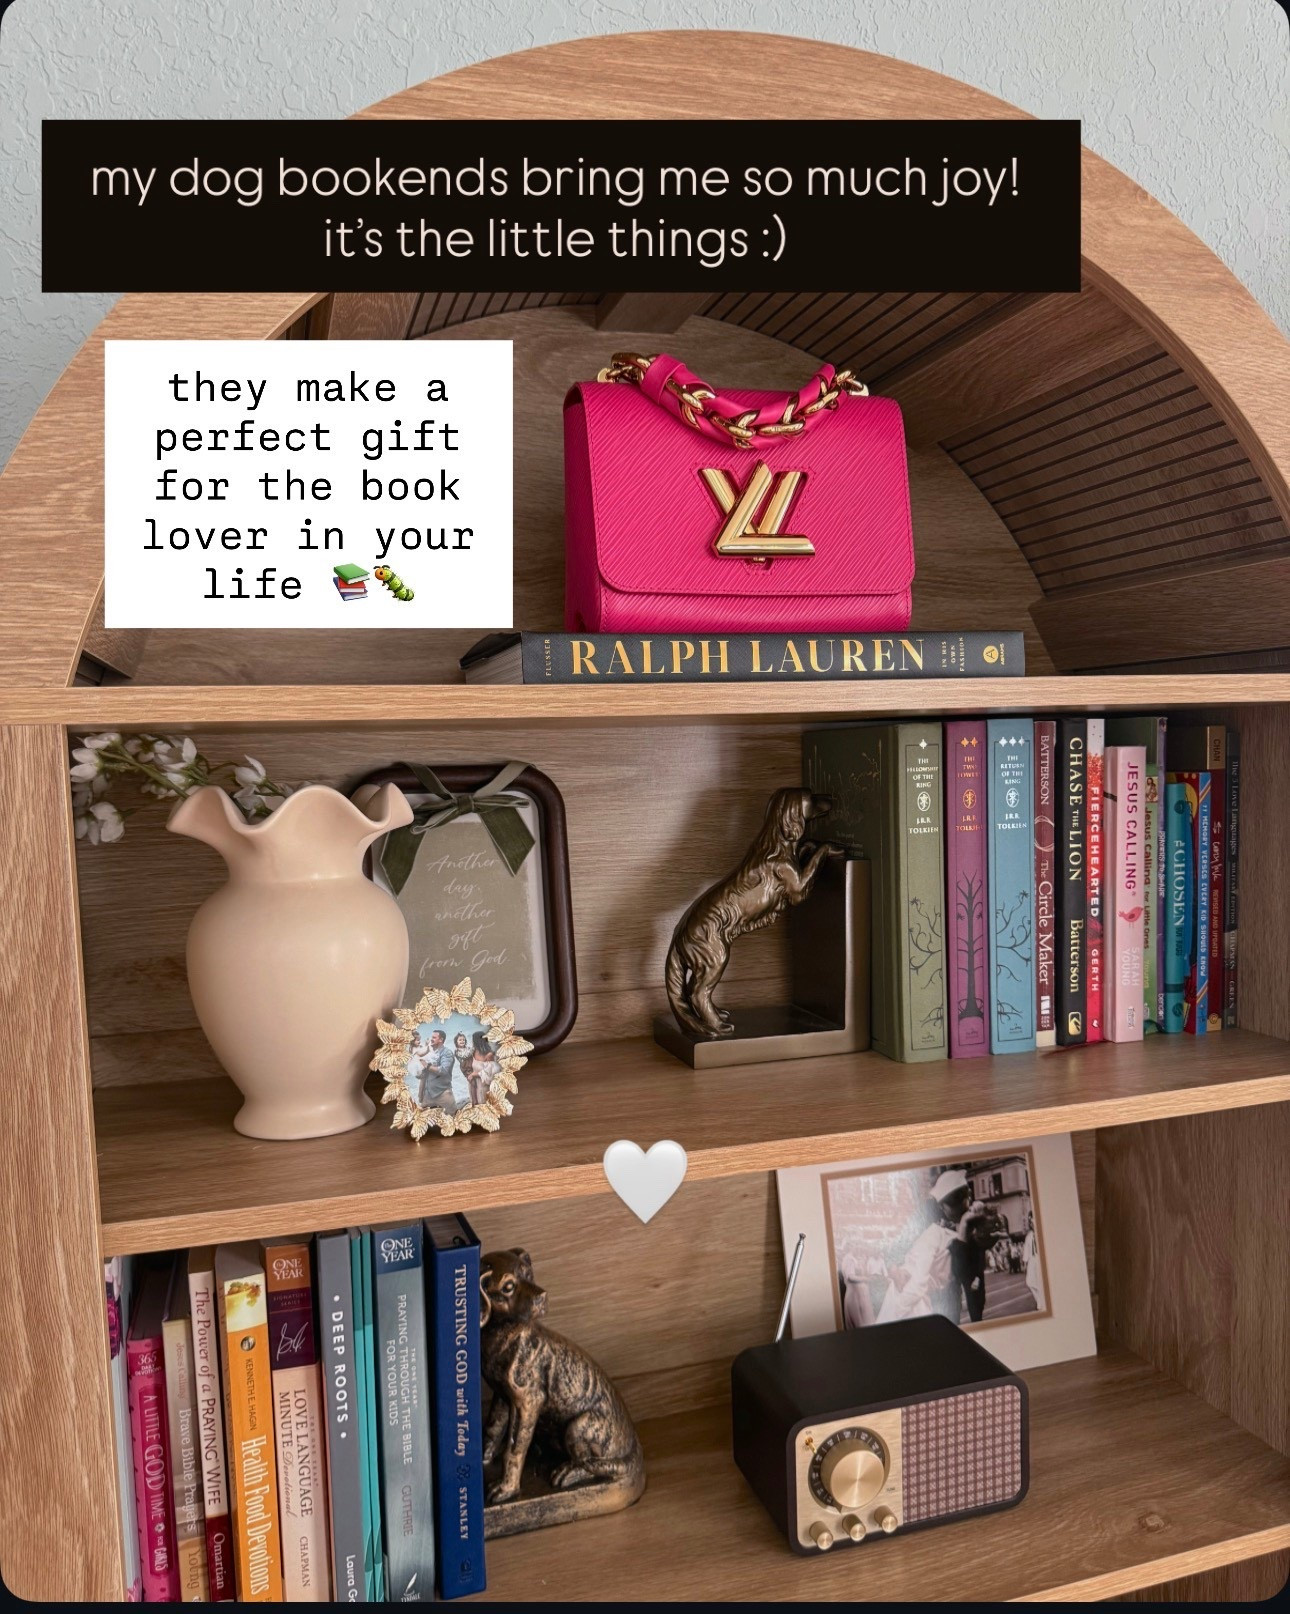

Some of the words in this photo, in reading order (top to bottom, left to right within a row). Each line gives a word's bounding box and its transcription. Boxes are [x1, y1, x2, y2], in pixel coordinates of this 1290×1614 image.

[544, 639, 552, 676] FLUSSER
[570, 640, 730, 675] RALPH
[750, 638, 924, 674] LAUREN
[942, 659, 947, 668] IN
[1213, 738, 1221, 762] CHAN
[1041, 735, 1049, 805] BATTERSON
[1069, 737, 1083, 806] CHASE
[1126, 762, 1139, 814] JESUS
[1144, 807, 1152, 840] Jesus
[1230, 808, 1238, 855] Languages
[426, 851, 502, 873] Another
[1069, 830, 1082, 881] LION
[1091, 787, 1100, 917] FIERCEHEARTED
[1126, 820, 1138, 890] CALLING
[1144, 844, 1152, 885] Calling
[1038, 881, 1053, 928] Circle
[1173, 849, 1185, 926] CHOSEN
[435, 902, 496, 921] another
[449, 922, 495, 951] gift
[1070, 919, 1083, 993] Batterson
[419, 957, 464, 979] from
[1039, 933, 1054, 985] Maker
[1091, 949, 1099, 991] GERTH
[1120, 948, 1130, 986] YOUNG
[1131, 947, 1140, 986] SARAH
[381, 1237, 413, 1252] ONE
[273, 1258, 302, 1271] ONE
[274, 1268, 303, 1280] YEAR
[196, 1287, 209, 1315] The
[398, 1294, 408, 1344] PRAYING
[454, 1264, 468, 1346] TRUSTING
[197, 1320, 211, 1361] Power
[331, 1311, 345, 1355] DEEP
[386, 1340, 396, 1362] FOR
[138, 1351, 157, 1365] 365
[199, 1366, 215, 1380] of
[245, 1357, 256, 1395] KENNETH
[399, 1348, 411, 1404] THROUGH
[455, 1349, 468, 1384] GOD
[143, 1395, 158, 1403] A
[202, 1385, 211, 1393] a
[334, 1364, 349, 1423] ROOTS
[387, 1365, 397, 1397] YOUR
[249, 1405, 257, 1430] HAGIN
[279, 1392, 293, 1448] MINUTE
[294, 1388, 308, 1429] LOVE
[388, 1399, 398, 1426] KIDS
[401, 1406, 411, 1432] THE
[456, 1388, 468, 1416] with
[144, 1407, 160, 1442] LITTLE
[180, 1408, 192, 1445] Brave
[454, 1421, 469, 1457] Today
[145, 1444, 166, 1490] GOD
[181, 1447, 195, 1481] Bible
[242, 1435, 269, 1486] Health
[402, 1434, 412, 1464] BIBLE
[206, 1466, 221, 1506] WIFE
[280, 1451, 297, 1518] Devotional
[296, 1432, 313, 1517] LANGUAGE
[150, 1492, 165, 1520] TIME
[182, 1483, 196, 1532] Prayers
[244, 1484, 271, 1524] Food
[402, 1485, 413, 1536] GUTHRIE
[459, 1487, 468, 1540] STANLEY
[154, 1546, 168, 1571] GIRLS
[187, 1547, 200, 1589] Young
[214, 1533, 226, 1589] Omartian
[247, 1522, 273, 1596] Devotions
[299, 1536, 311, 1587] CHAPMAN
[346, 1554, 356, 1586] Laura
